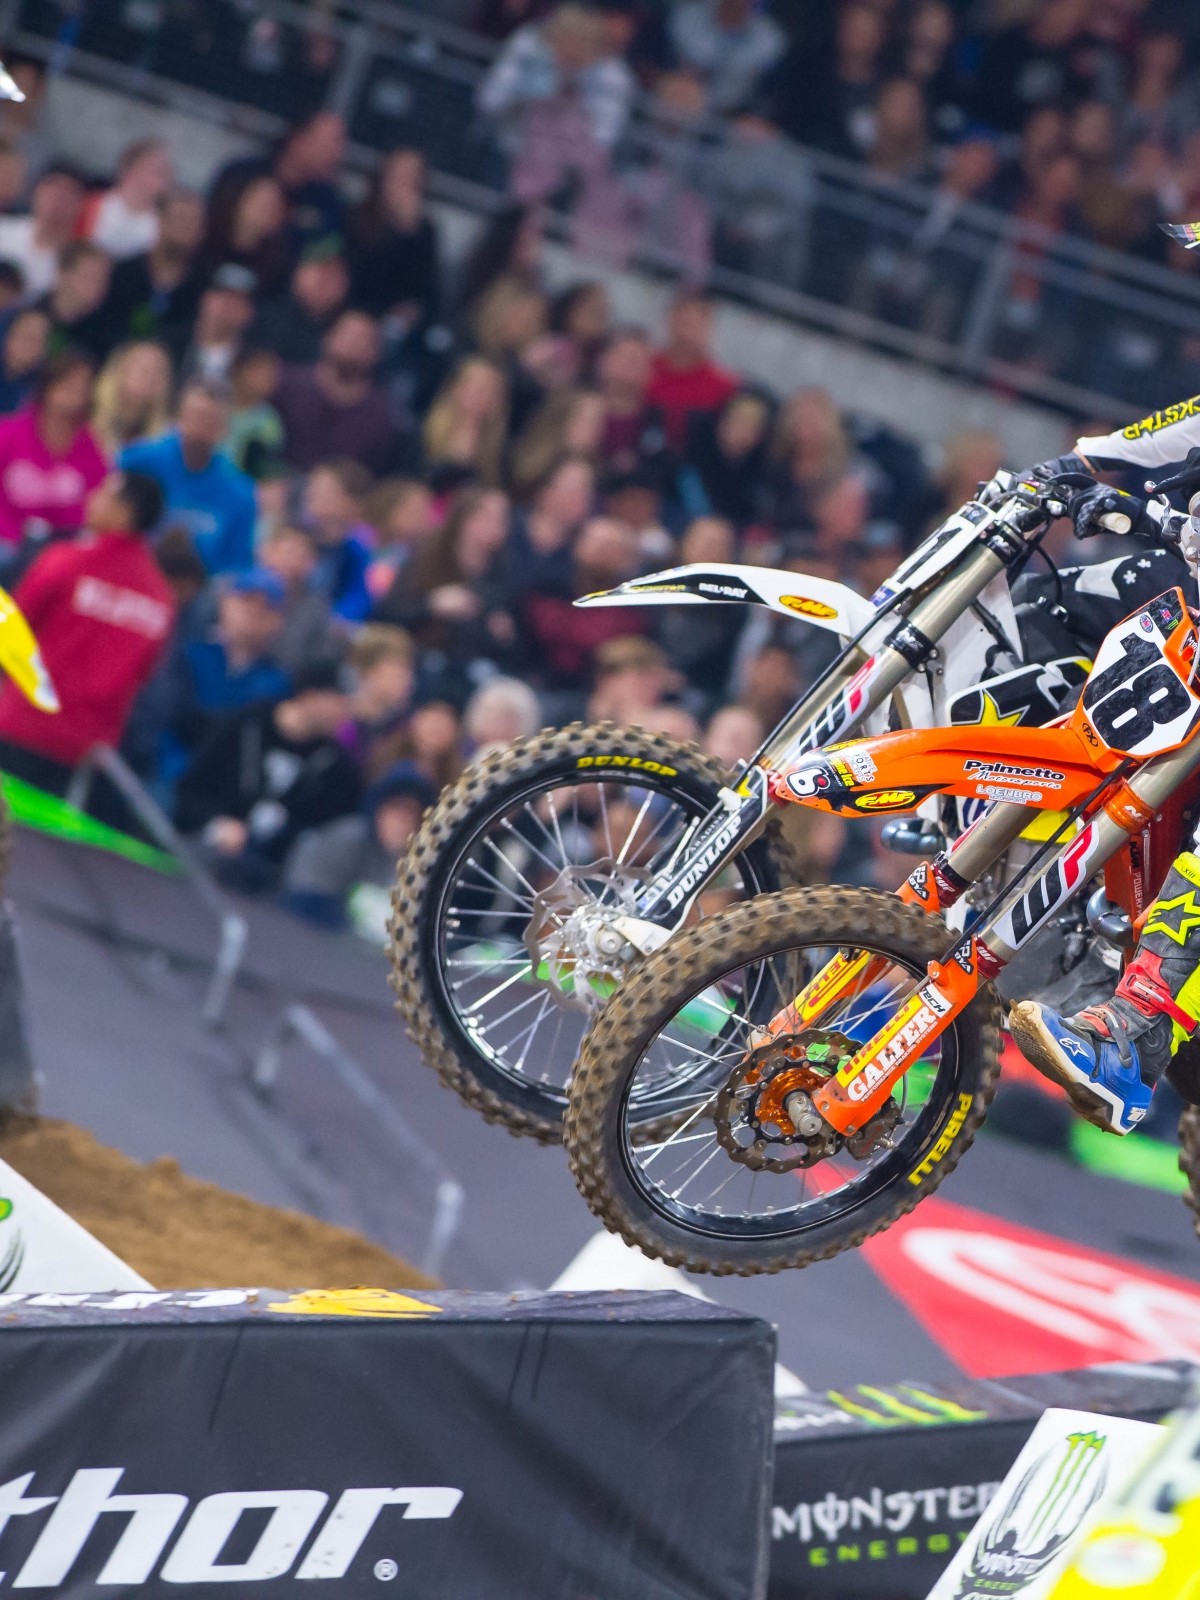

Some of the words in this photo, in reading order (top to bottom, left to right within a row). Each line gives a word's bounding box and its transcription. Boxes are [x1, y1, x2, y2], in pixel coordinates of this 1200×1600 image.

[1082, 632, 1192, 752] 18
[576, 755, 678, 777] DUNLOP
[964, 760, 1066, 781] Palmetto
[968, 770, 1062, 790] Motorsports
[856, 790, 916, 808] FMF
[976, 784, 1043, 802] LOENBRO
[667, 815, 742, 908] DUNLOP
[843, 1003, 911, 1075] PIRELLI
[847, 1006, 937, 1102] GALFER
[907, 1091, 973, 1186] PIRELLI
